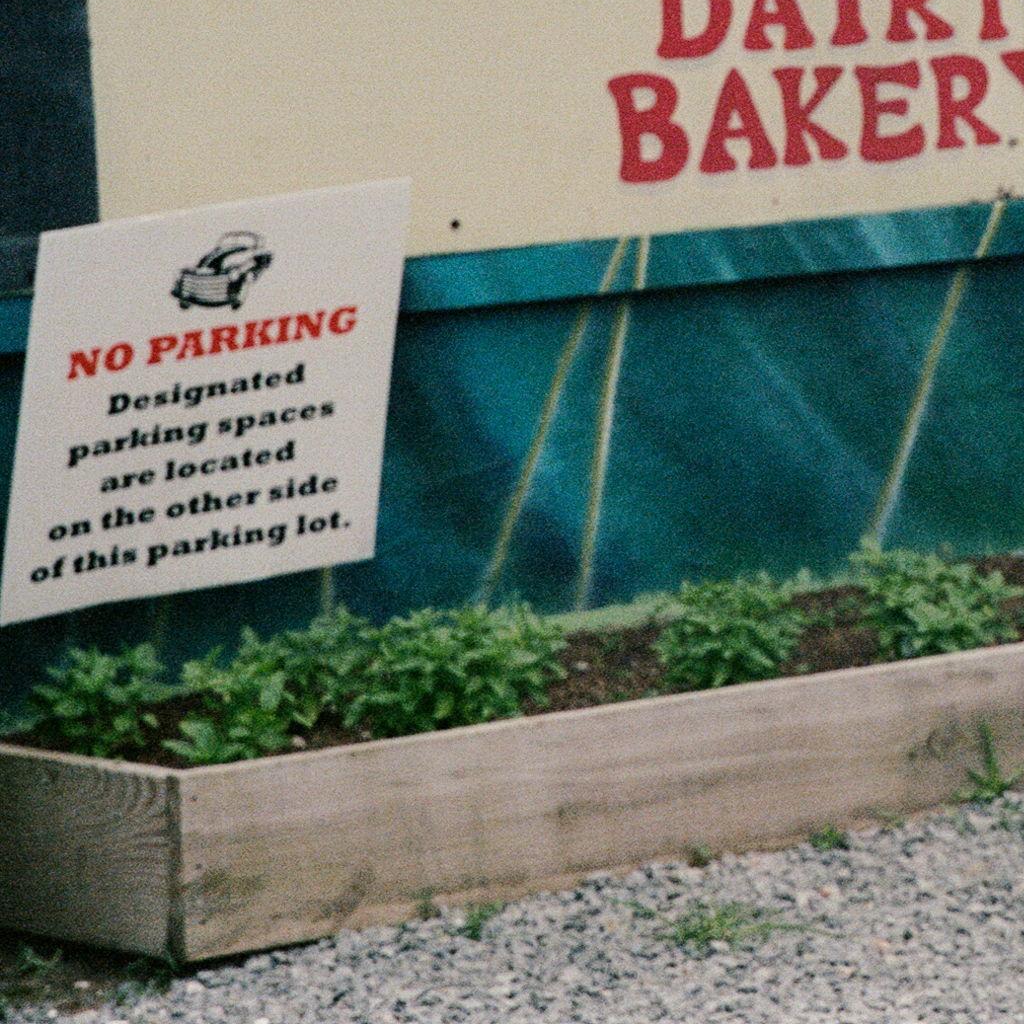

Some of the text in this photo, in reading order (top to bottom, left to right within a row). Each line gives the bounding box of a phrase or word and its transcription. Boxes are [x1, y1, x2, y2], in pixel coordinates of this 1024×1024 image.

[67, 306, 358, 381] NO PARKING
[107, 363, 305, 416] Designated
[67, 402, 334, 468] parking spaces
[100, 440, 295, 493] are located
[48, 474, 338, 542] on the other side
[30, 511, 350, 583] of this parking lot.
